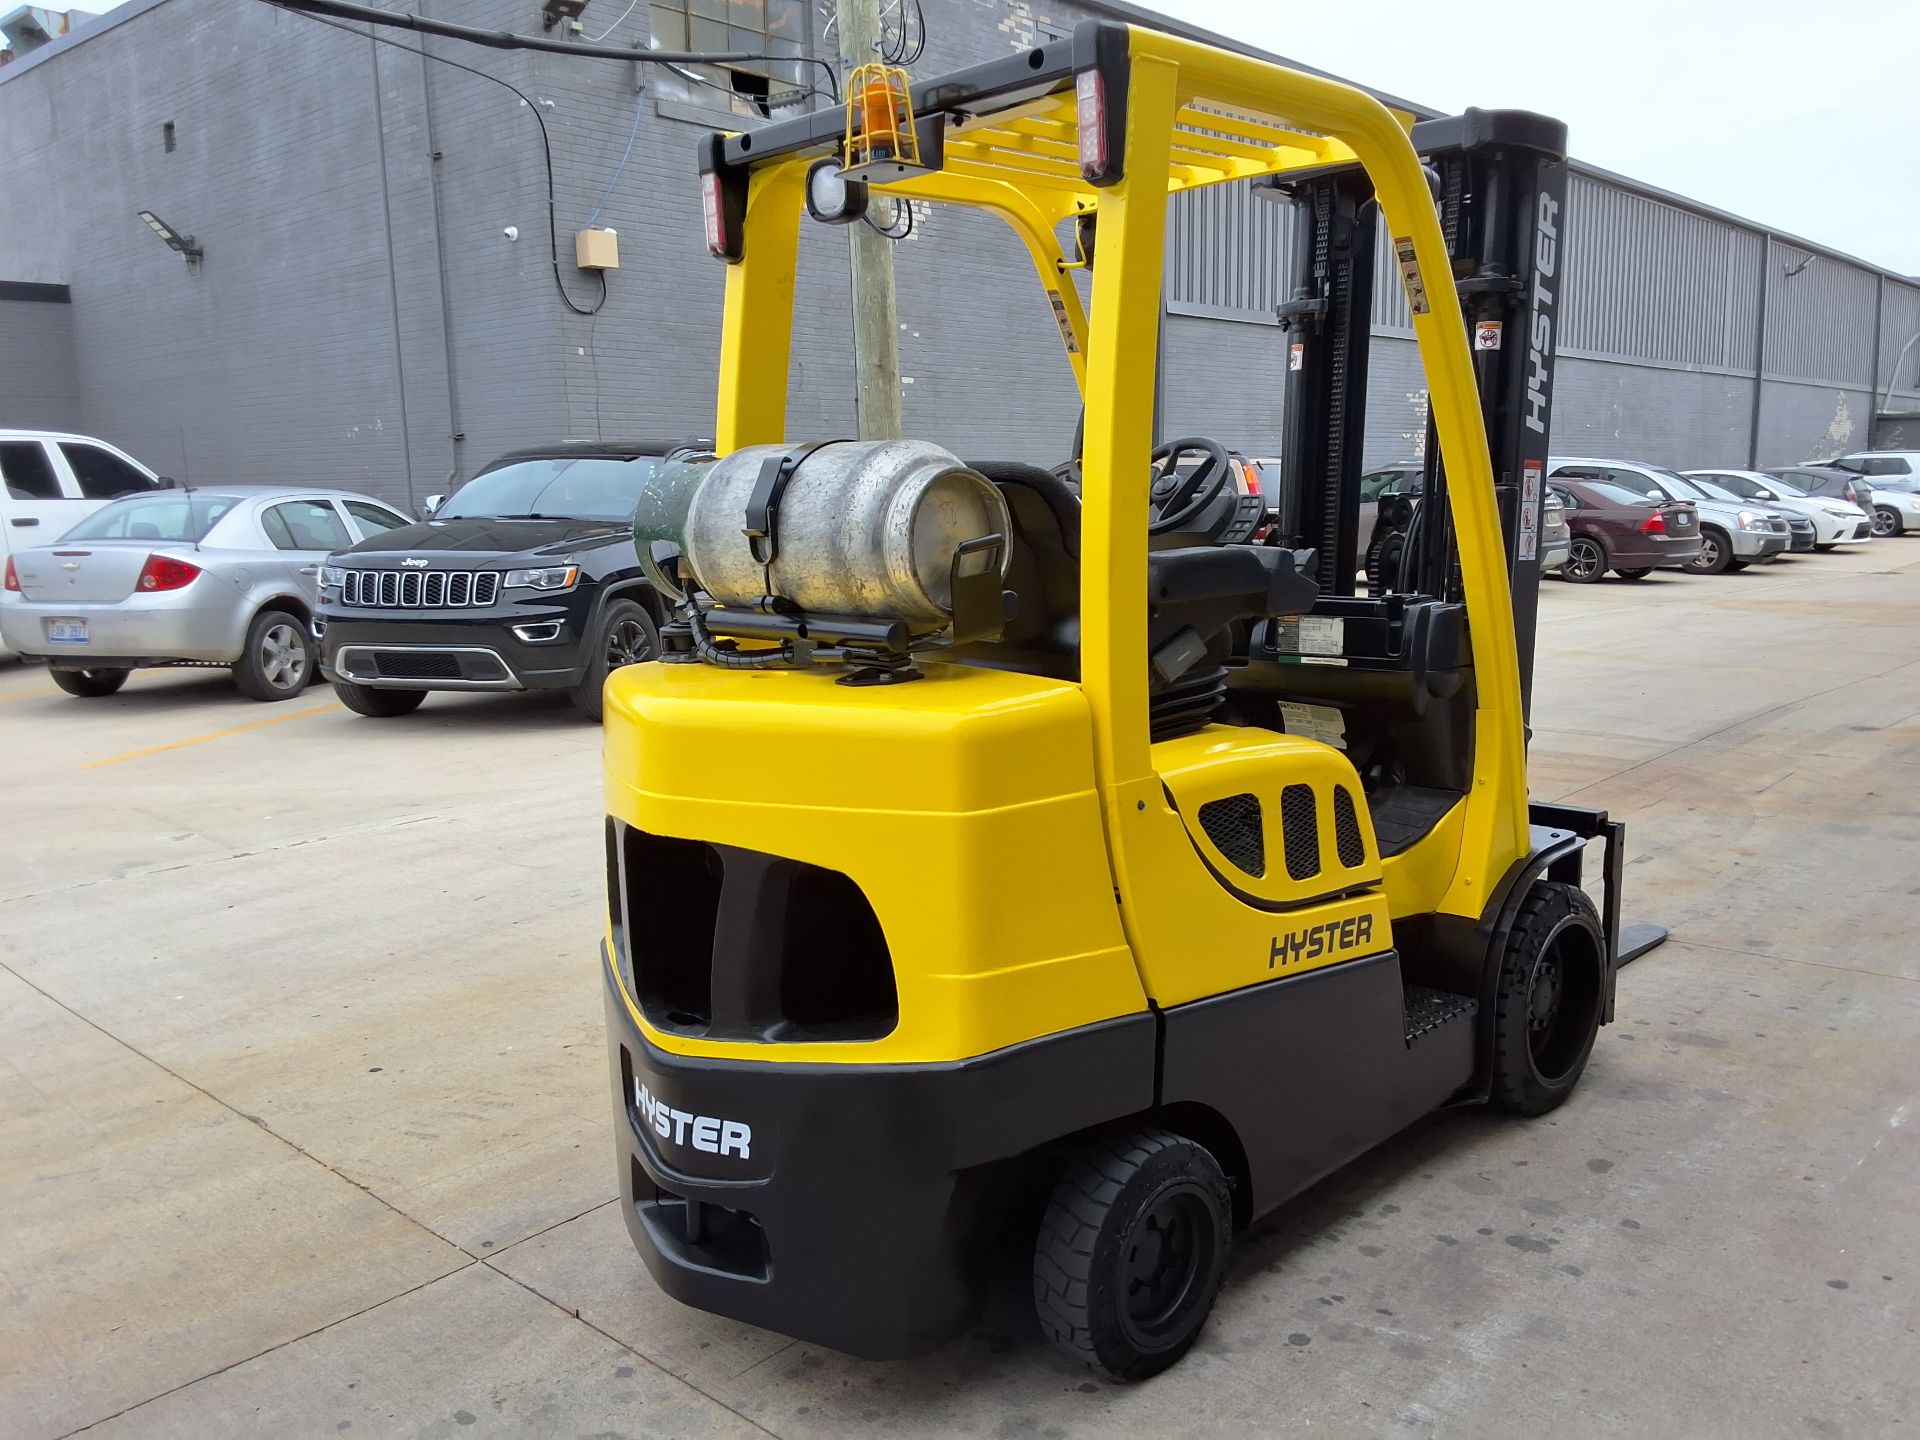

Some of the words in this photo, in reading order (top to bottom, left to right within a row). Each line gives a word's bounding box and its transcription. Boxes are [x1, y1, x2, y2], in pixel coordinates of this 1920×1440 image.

[1526, 191, 1558, 434] HYSTER
[401, 557, 429, 568] Jeep
[1269, 913, 1373, 969] HYSTER
[635, 1076, 752, 1160] HYSTER
